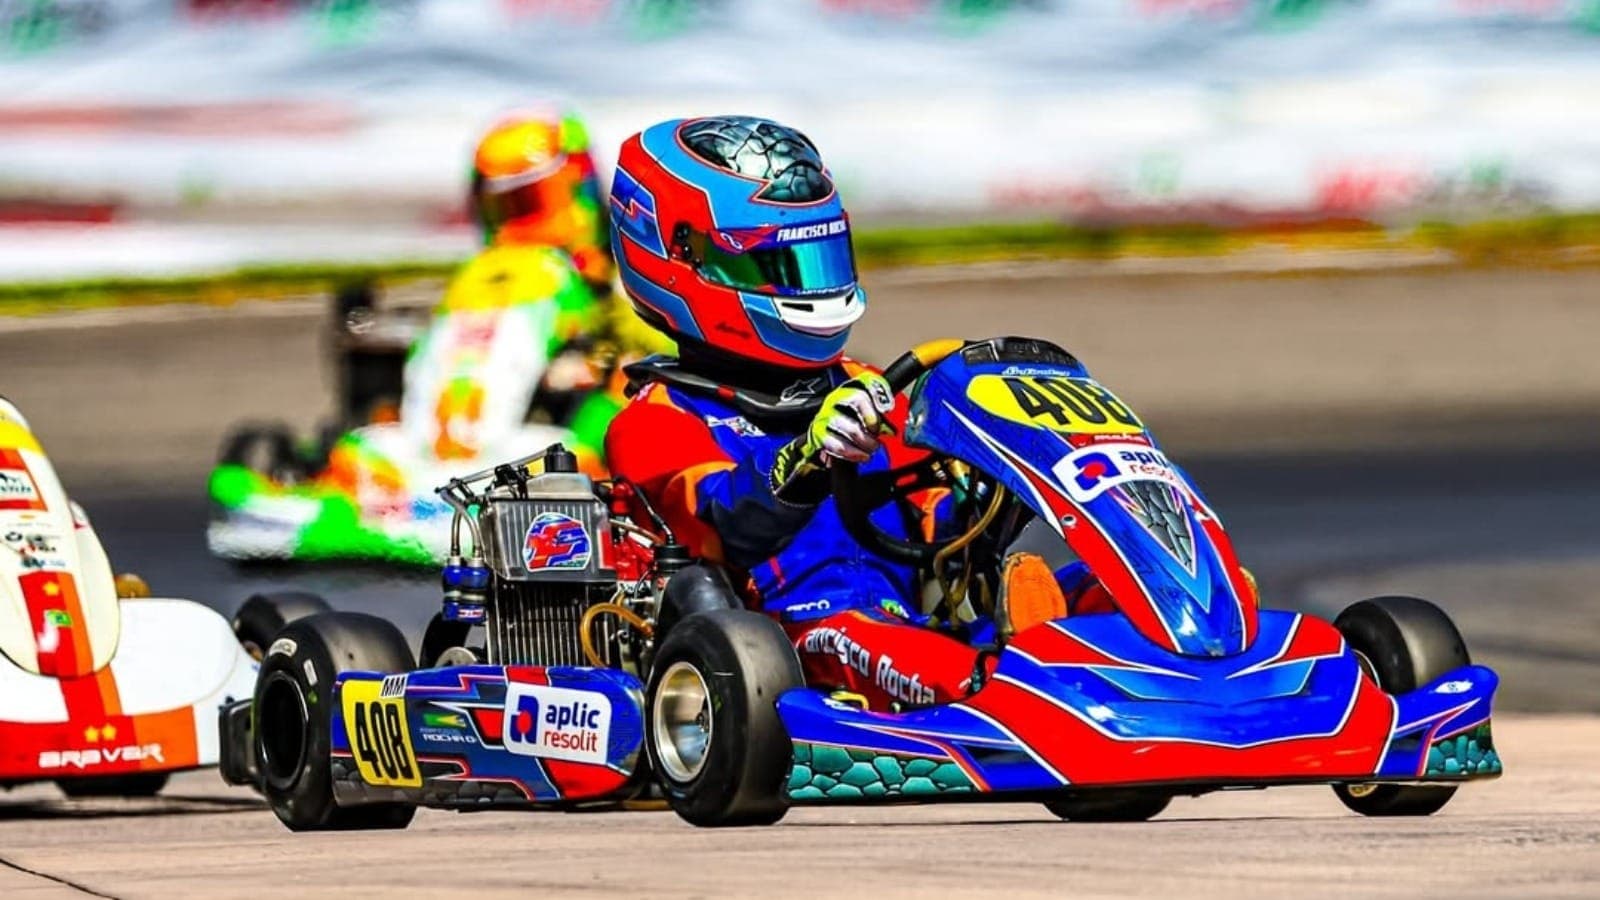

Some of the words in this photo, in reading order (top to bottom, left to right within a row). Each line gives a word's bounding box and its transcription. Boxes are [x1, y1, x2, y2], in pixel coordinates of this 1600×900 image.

[776, 223, 828, 242] FRANCISCO
[1001, 377, 1143, 426] 408
[805, 626, 870, 677] ancisco
[876, 654, 935, 704] Rocha
[545, 701, 601, 731] aplic
[355, 701, 415, 780] 408
[544, 728, 598, 753] resolit
